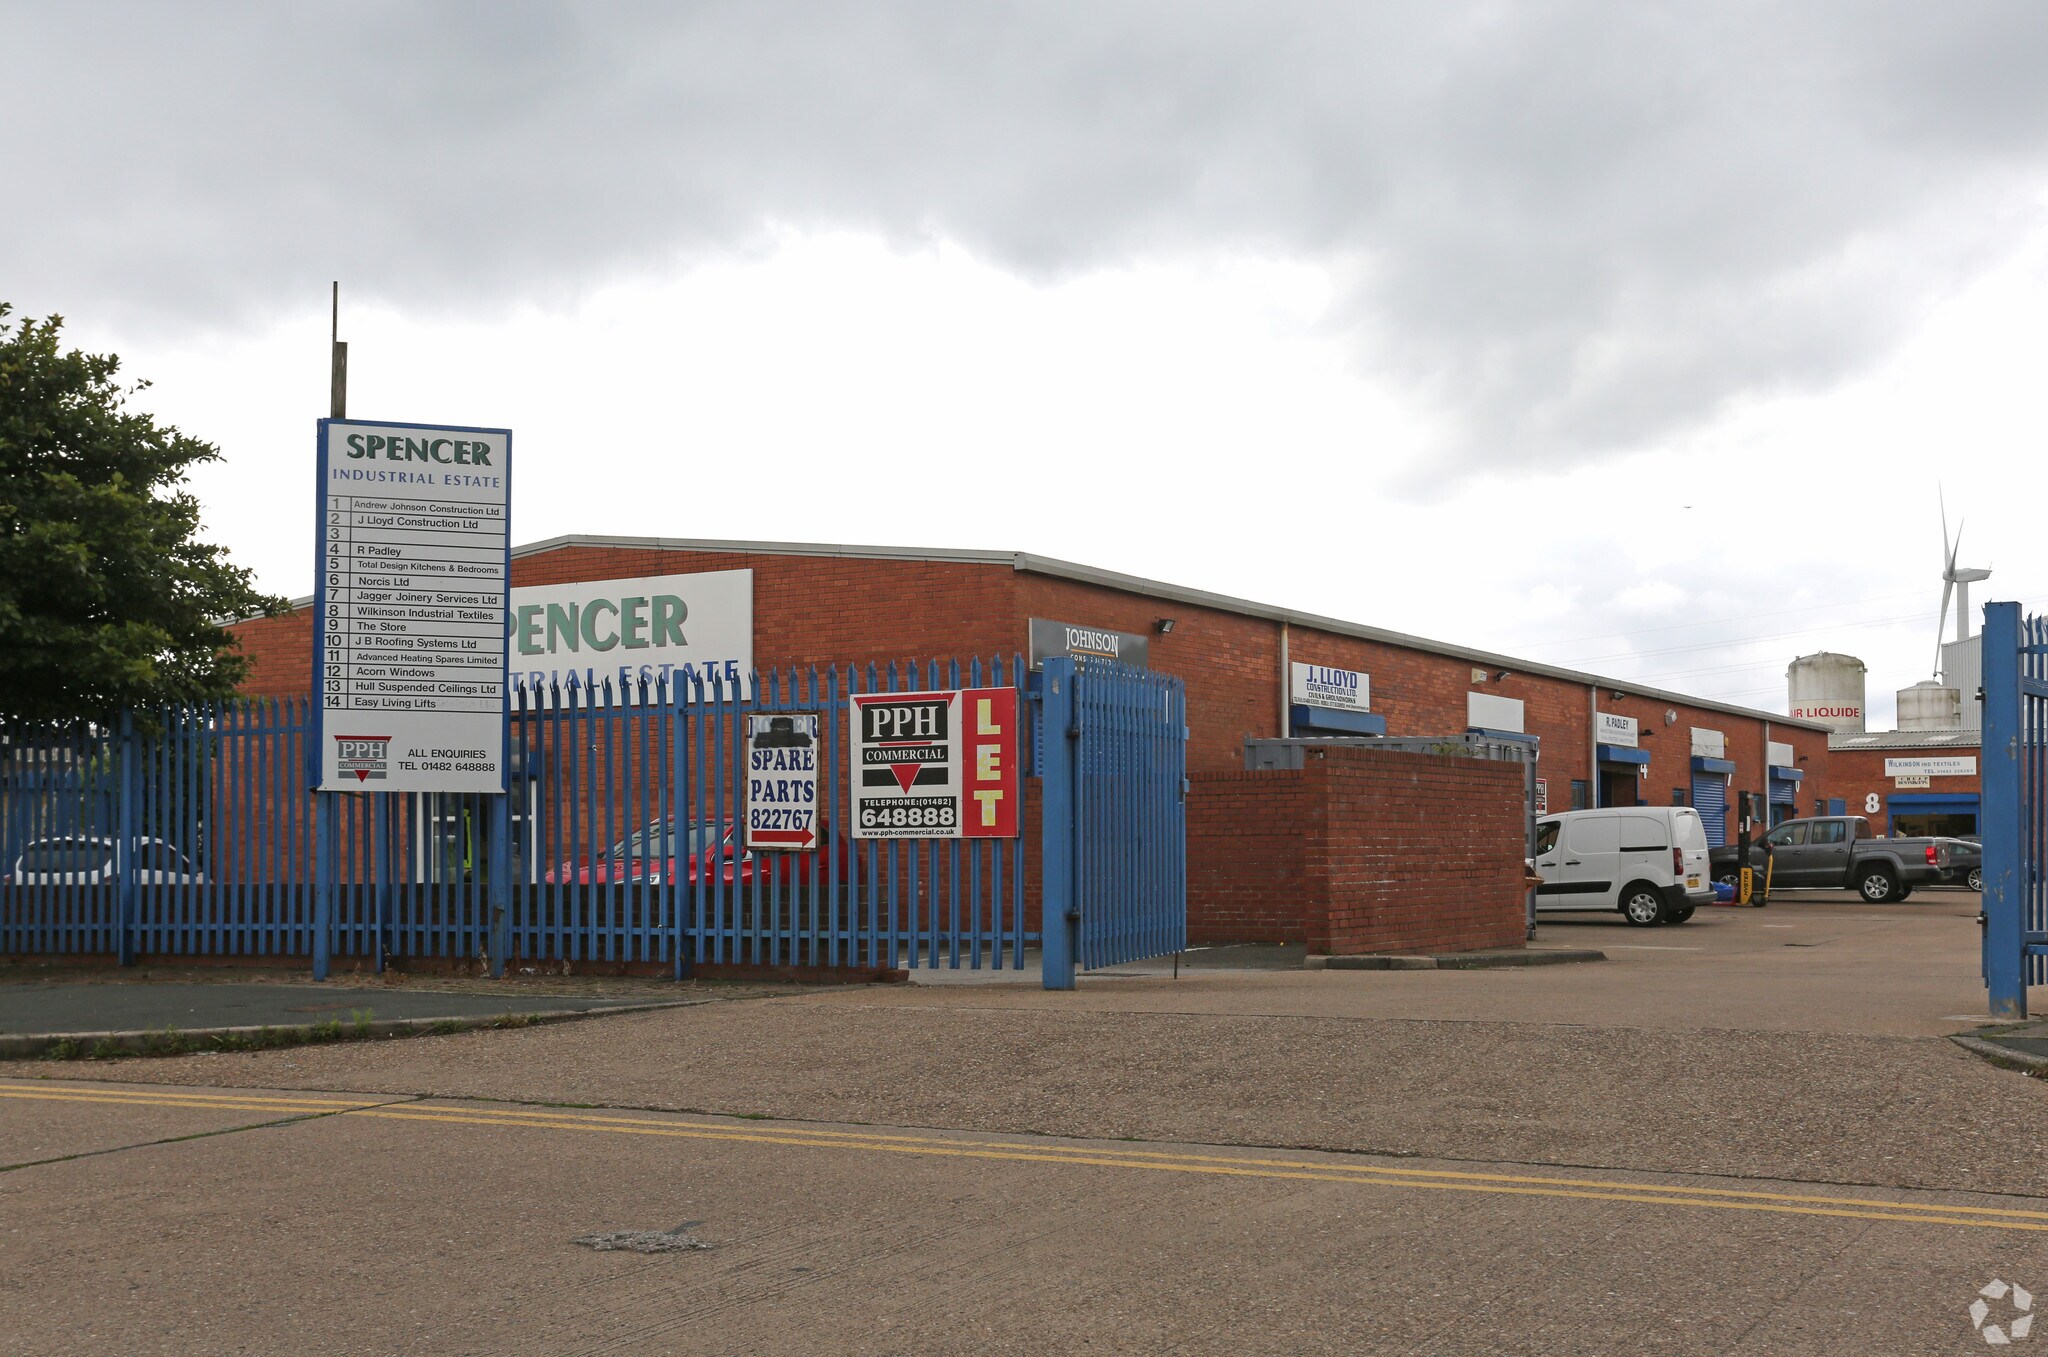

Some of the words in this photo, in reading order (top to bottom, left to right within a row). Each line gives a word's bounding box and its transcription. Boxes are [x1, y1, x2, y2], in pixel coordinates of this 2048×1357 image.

[347, 434, 492, 466] SPENCER
[333, 469, 435, 484] INDUSTRIAL
[445, 475, 500, 488] ESTATE
[332, 498, 339, 509] 1
[354, 501, 387, 510] Andrew
[390, 503, 426, 512] Johnson
[430, 505, 483, 515] Construction
[486, 506, 499, 516] Ltd
[331, 513, 340, 524] 2
[358, 516, 364, 524] J
[368, 516, 394, 525] Lloyd
[397, 517, 460, 528] Construction
[463, 519, 478, 529] Ltd
[330, 528, 340, 539] 3
[330, 544, 340, 554] 4
[358, 546, 365, 554] R
[368, 546, 401, 557] Padley
[330, 558, 339, 569] 5
[380, 562, 408, 571] Design
[410, 563, 446, 572] Kitchens
[458, 565, 499, 574] Bedrooms
[330, 574, 339, 585] 6
[359, 577, 390, 586] Norcis
[394, 578, 410, 587] Ltd
[330, 589, 339, 600] 7
[357, 591, 392, 602] Jagger
[396, 593, 432, 604] Joinery
[436, 594, 479, 604] Services
[482, 596, 498, 605] Ltd
[329, 605, 338, 616] 8
[358, 607, 406, 617] Wilkinson
[409, 608, 454, 618] Industrial
[458, 610, 494, 620] Textiles
[329, 620, 338, 630] 9
[357, 622, 376, 630] The
[380, 622, 406, 632] Store
[326, 635, 341, 646] 10
[355, 637, 361, 645] J
[365, 637, 372, 645] B
[375, 638, 413, 648] Roofing
[417, 639, 458, 650] Systems
[462, 640, 477, 648] Ltd
[1066, 628, 1119, 657] JOHNSON
[328, 650, 340, 661] 11
[357, 653, 398, 662] Advanced
[401, 654, 432, 664] Heating
[436, 656, 464, 665] Spares
[467, 656, 497, 665] Limited
[326, 665, 341, 676] 12
[357, 667, 386, 676] Acorn
[390, 668, 435, 677] Windows
[619, 660, 739, 687] ESTATE
[1307, 666, 1317, 683] J.
[1321, 668, 1357, 689] LLOYD
[325, 681, 341, 691] 13
[355, 682, 375, 691] Hull
[378, 682, 435, 694] Suspended
[438, 684, 477, 694] Ceilings
[481, 685, 496, 694] Ltd
[1307, 683, 1346, 696] CONSTRUCTION
[325, 696, 340, 707] 14
[355, 698, 378, 708] Easy
[382, 698, 411, 709] Living
[415, 699, 436, 708] Lifts
[1807, 707, 1860, 718] LIQUIDE
[870, 706, 938, 738] PPH
[1612, 718, 1629, 730] PADLEY
[341, 742, 385, 758] PPH
[408, 749, 427, 758] ALL
[431, 750, 486, 759] ENQUIRIES
[866, 748, 944, 762] COMMERCIAL
[398, 762, 417, 770] TEL
[422, 762, 452, 771] 01482
[455, 763, 495, 771] 648888
[751, 749, 814, 771] SPARE
[974, 699, 1004, 826] LET
[751, 780, 814, 802] PARTS
[864, 798, 952, 807] TELEPHONE:(01482)
[1865, 792, 1880, 813] 8
[751, 808, 813, 830] 822767
[862, 808, 954, 826] 648888
